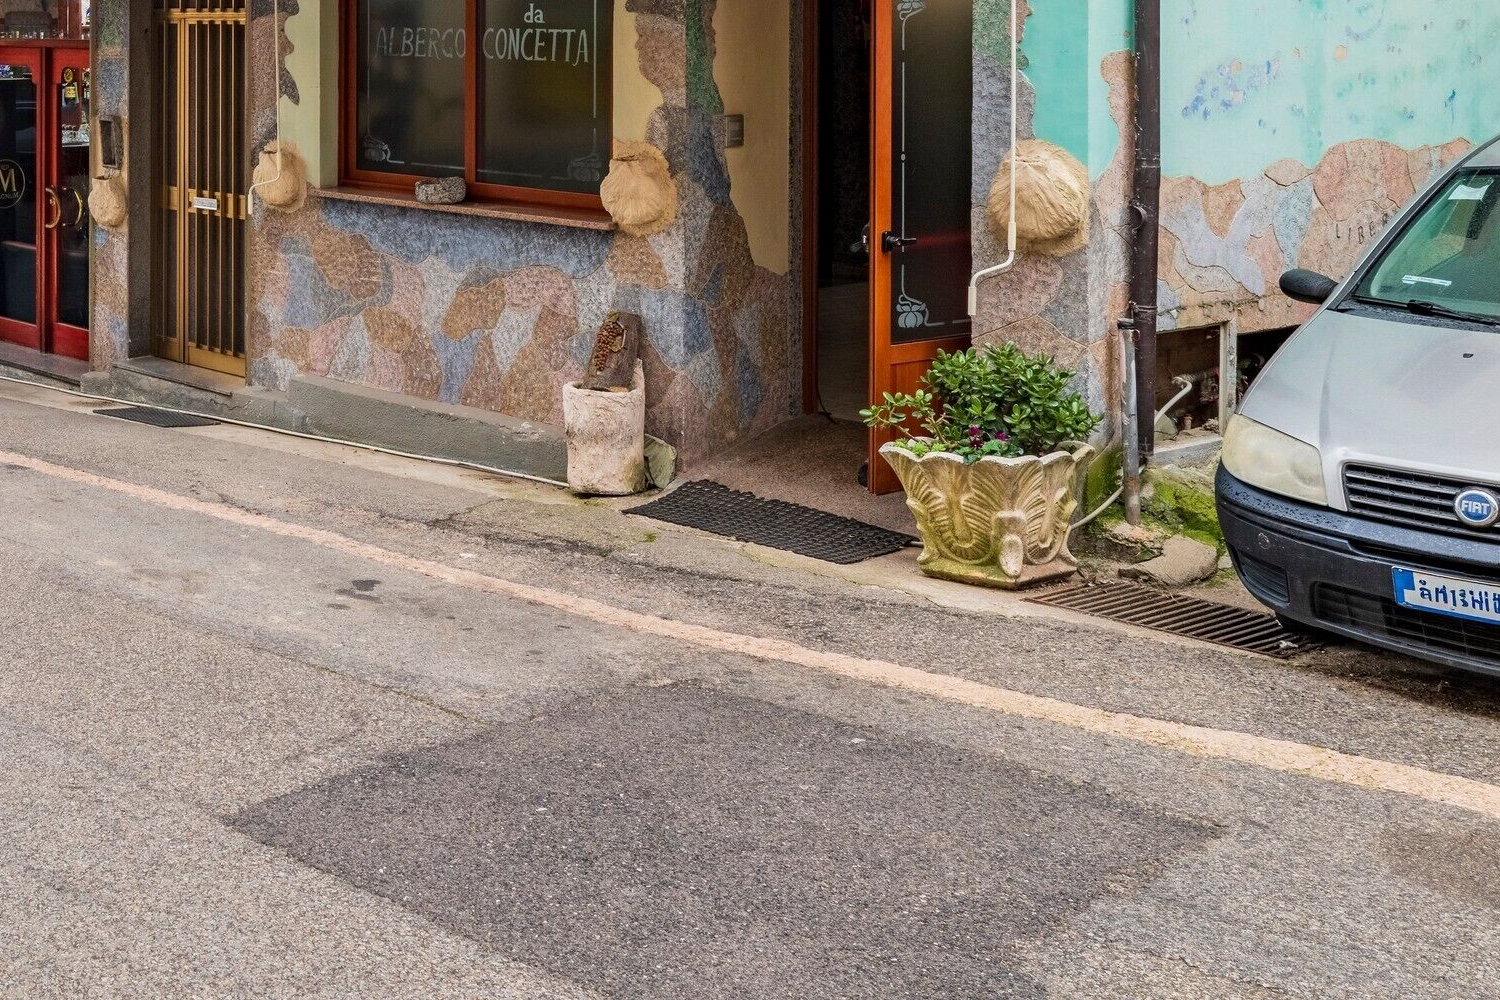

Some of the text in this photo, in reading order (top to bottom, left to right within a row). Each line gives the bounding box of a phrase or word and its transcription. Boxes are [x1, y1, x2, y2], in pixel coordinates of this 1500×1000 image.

[523, 2, 546, 24] da
[482, 27, 590, 67] CONCETTA
[1461, 499, 1490, 515] FIAT
